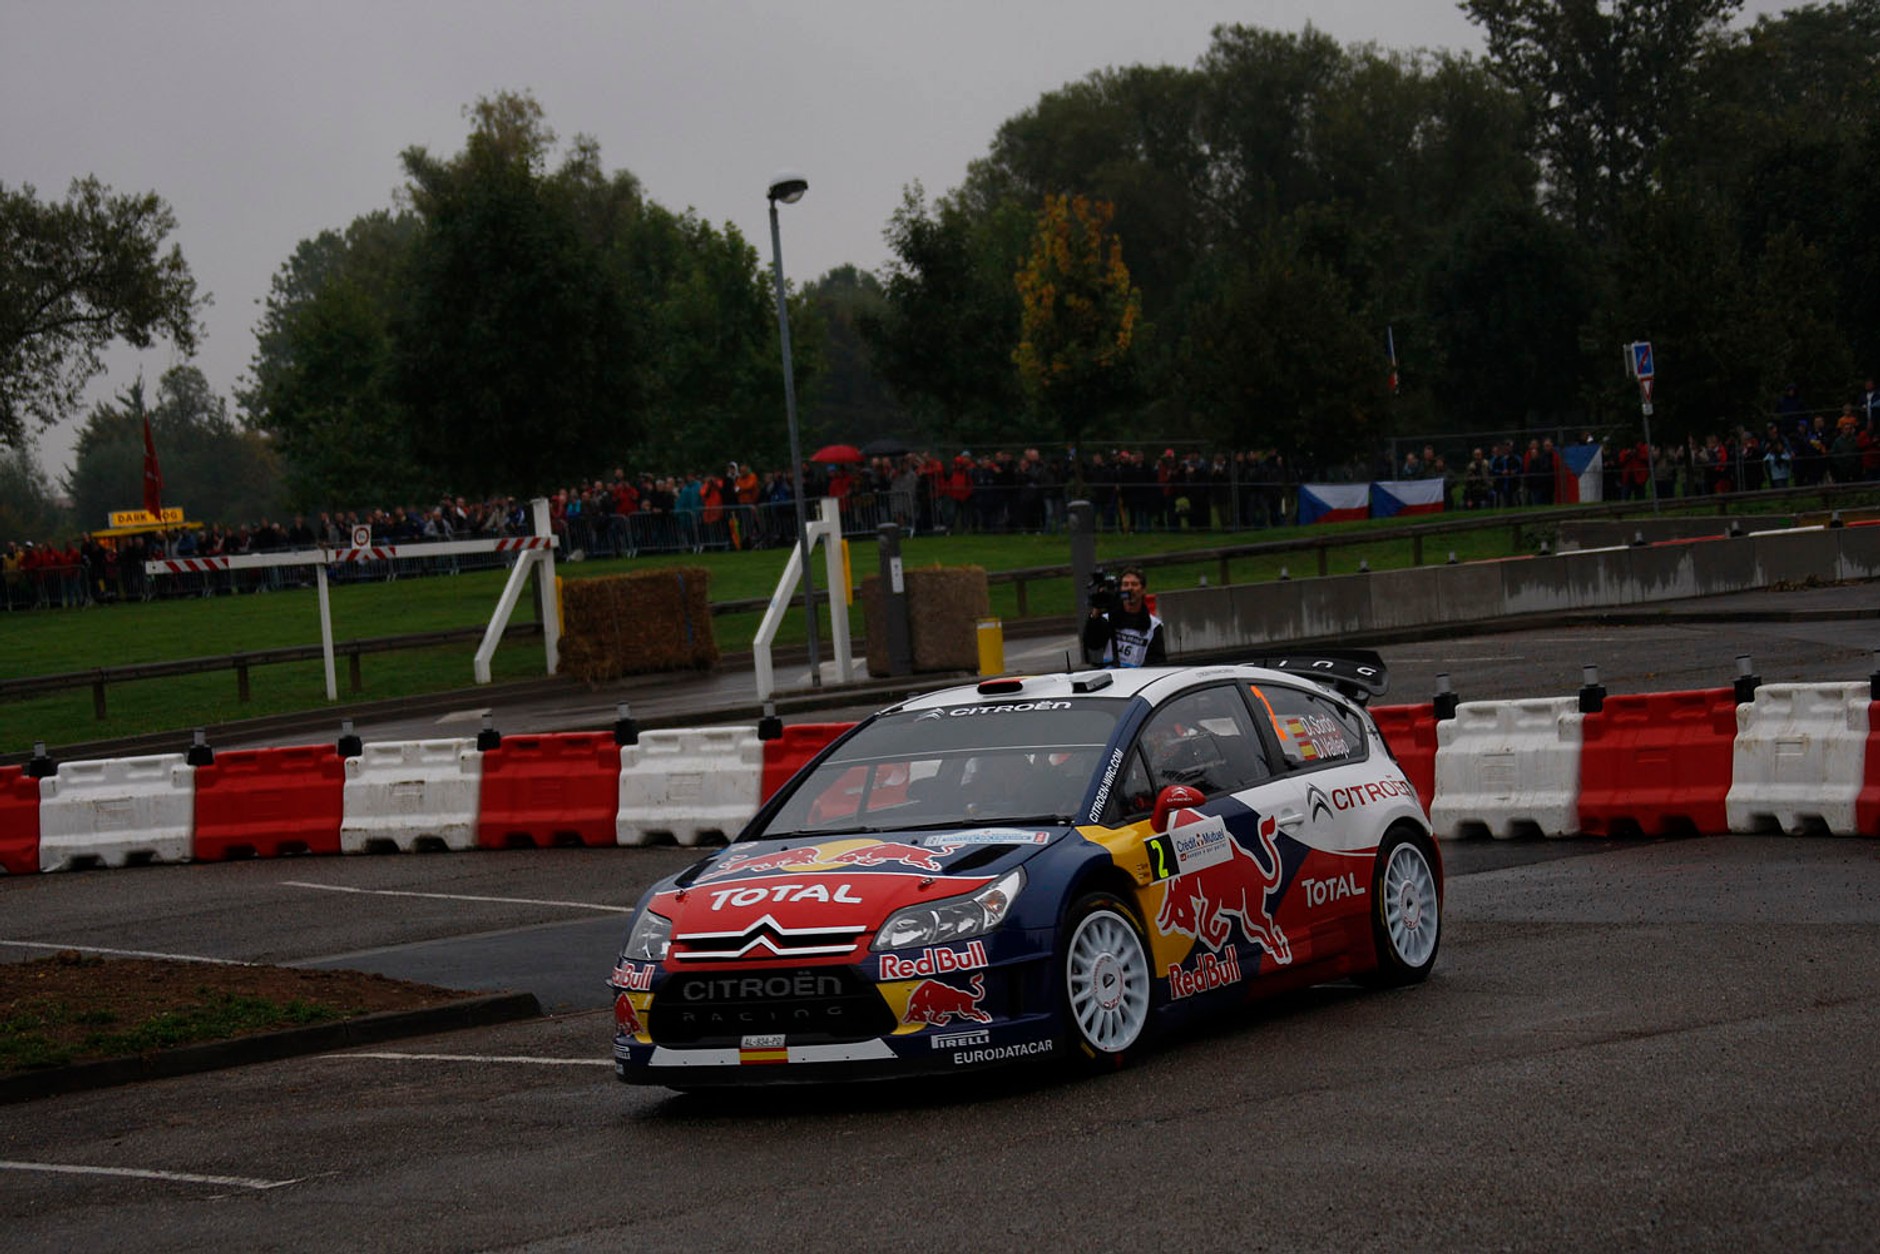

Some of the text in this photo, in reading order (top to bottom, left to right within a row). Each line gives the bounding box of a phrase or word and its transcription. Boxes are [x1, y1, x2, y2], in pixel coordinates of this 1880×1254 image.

[949, 701, 1072, 717] CITROËN
[1089, 747, 1124, 823] CITROEN-WRC.COM
[1150, 839, 1169, 878] 2
[710, 884, 863, 911] TOTAL
[1301, 872, 1366, 908] TOTAL
[683, 970, 843, 1001] CITROËN
[931, 1029, 990, 1050] PIRELLI
[953, 1039, 1053, 1065] EURODATACAR
